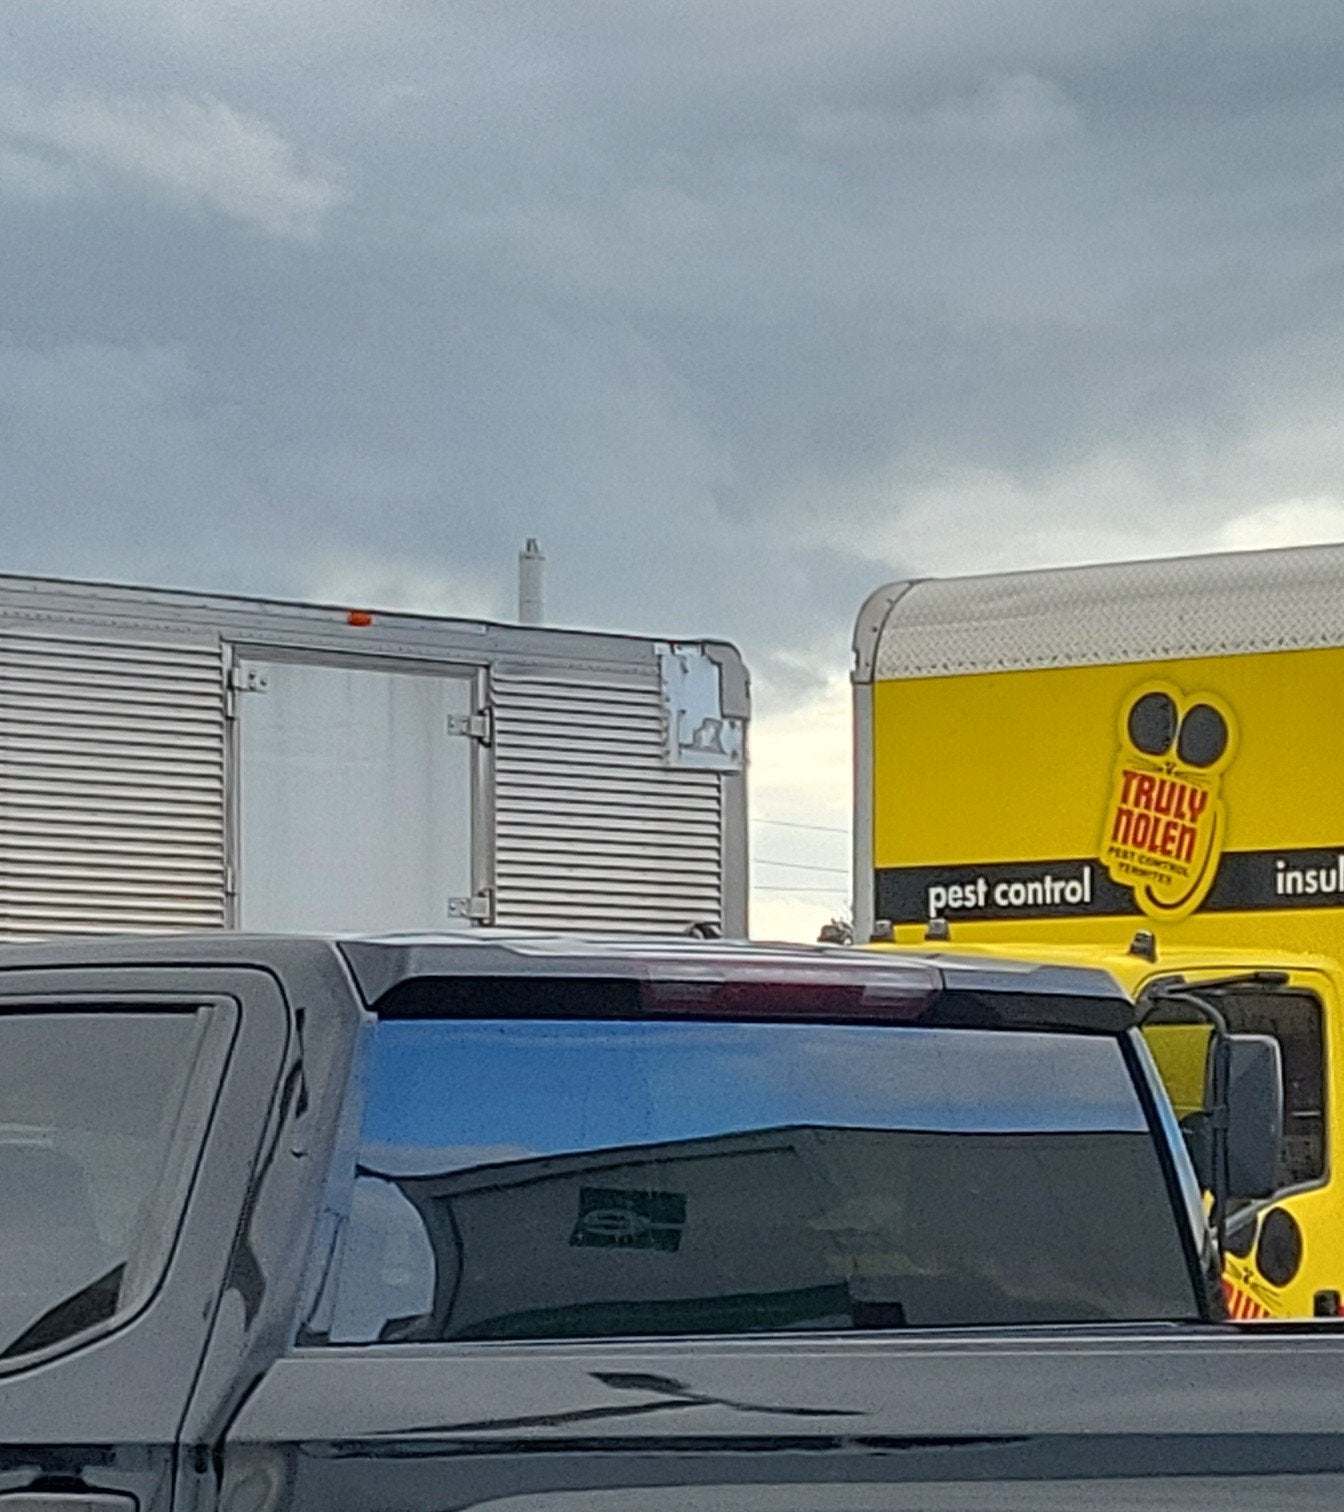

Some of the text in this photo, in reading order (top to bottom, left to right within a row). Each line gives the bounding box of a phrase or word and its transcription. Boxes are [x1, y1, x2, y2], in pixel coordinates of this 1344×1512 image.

[1121, 769, 1209, 823] TRULY
[1111, 806, 1198, 865] NOLEN
[929, 867, 1092, 918] pest control
